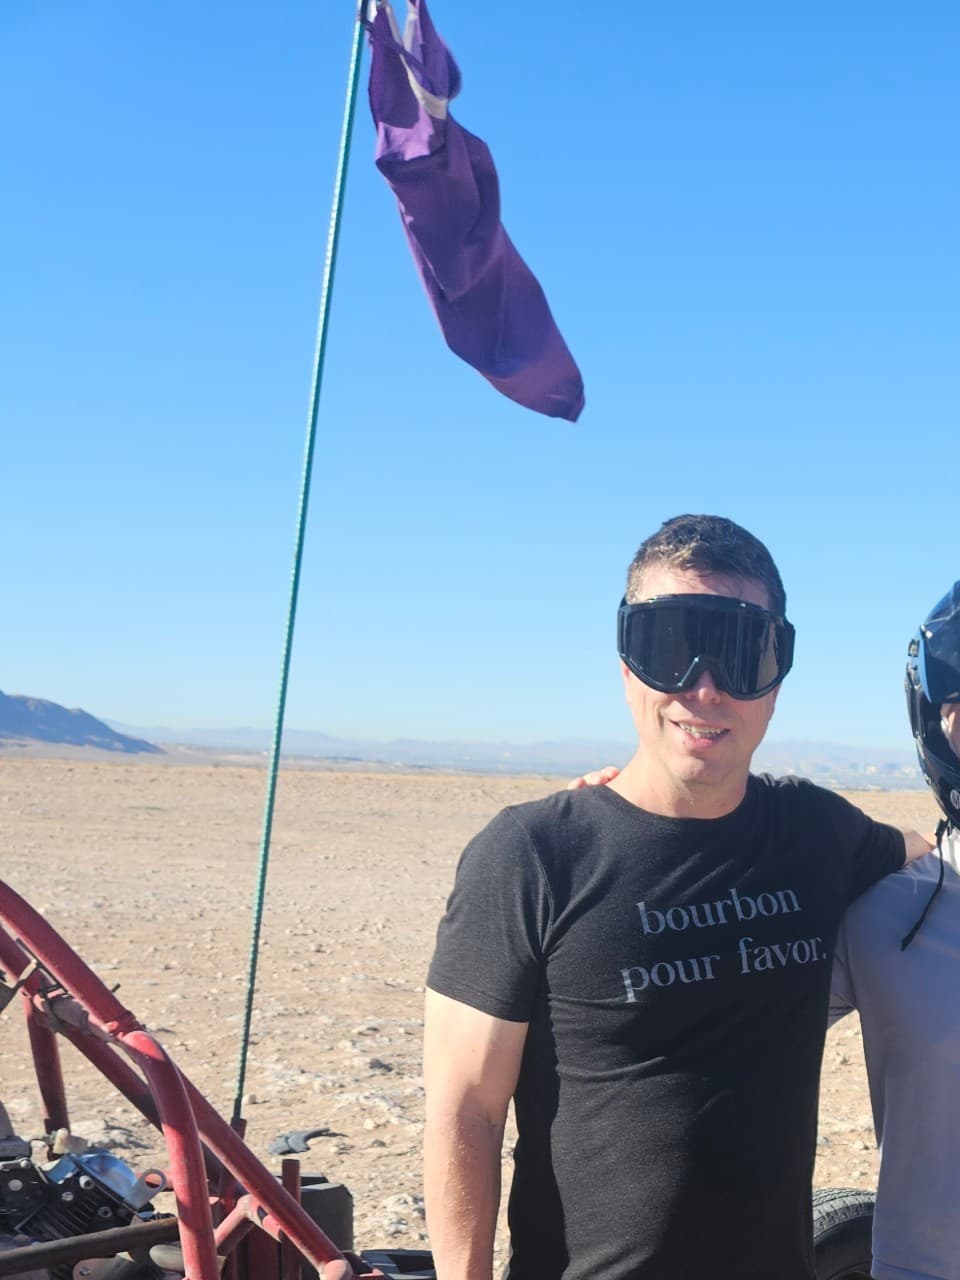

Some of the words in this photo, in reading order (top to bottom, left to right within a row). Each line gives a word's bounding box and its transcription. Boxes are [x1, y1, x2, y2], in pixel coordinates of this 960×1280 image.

[635, 888, 801, 936] bourbon
[620, 955, 721, 1003] pour
[737, 937, 827, 974] favor.
